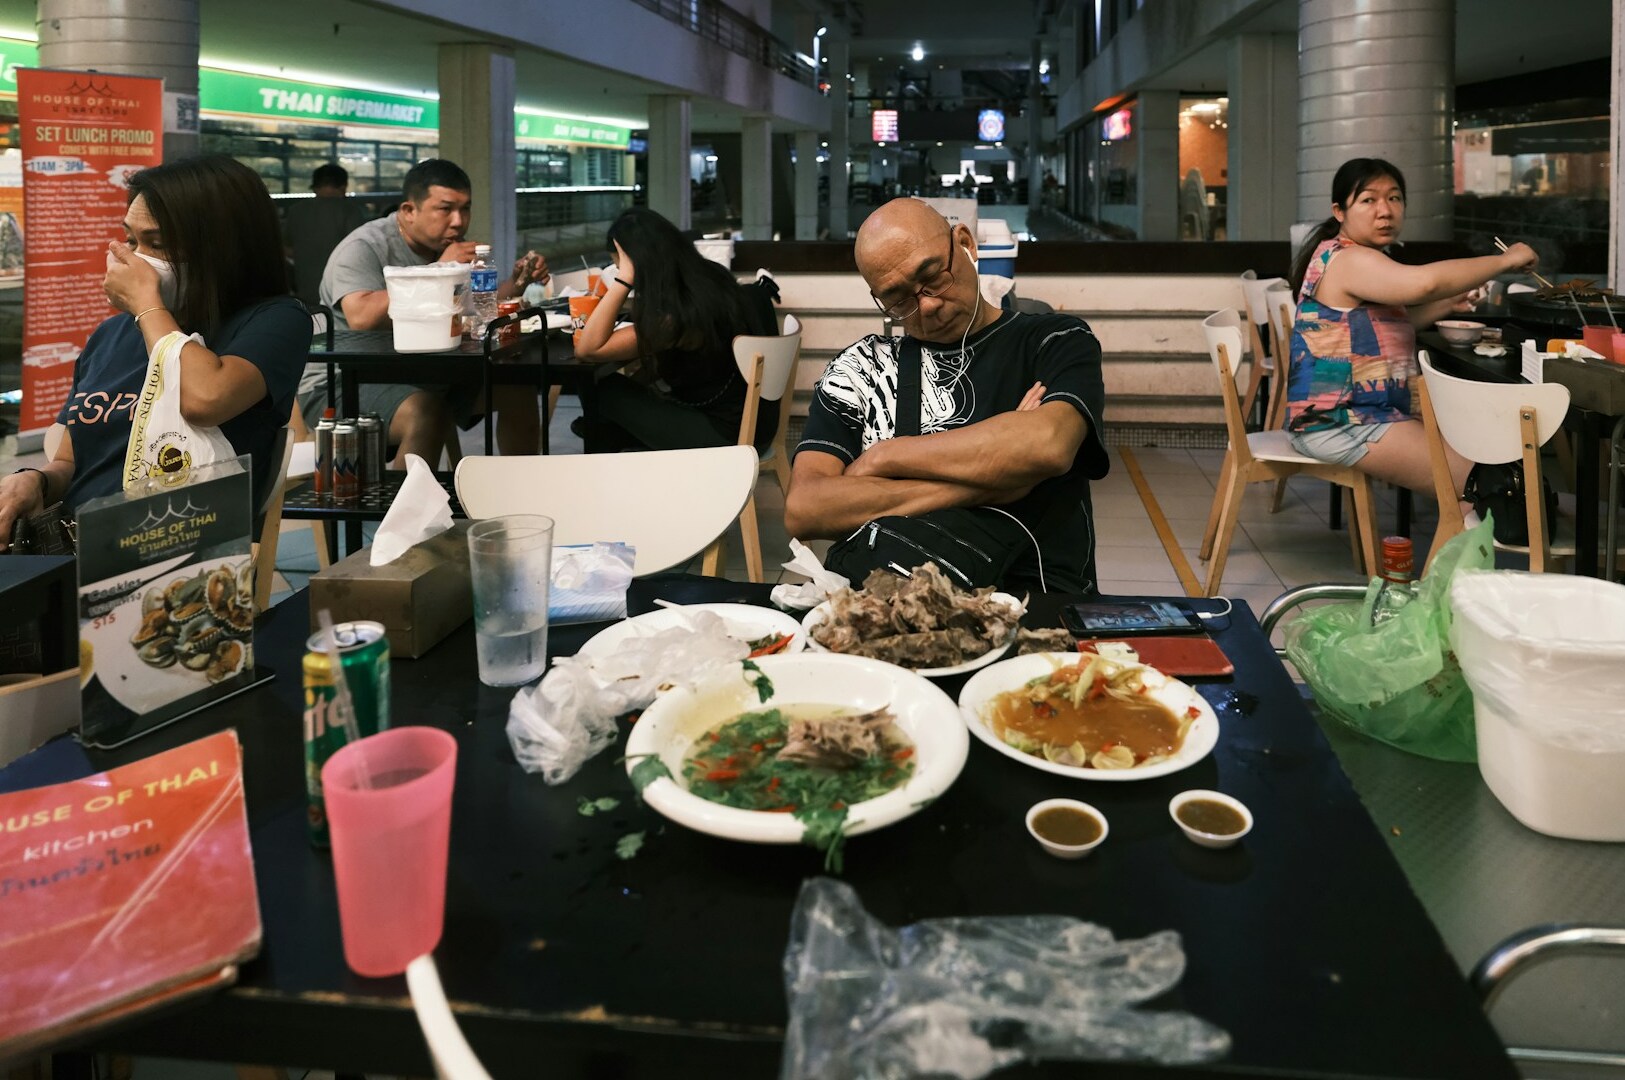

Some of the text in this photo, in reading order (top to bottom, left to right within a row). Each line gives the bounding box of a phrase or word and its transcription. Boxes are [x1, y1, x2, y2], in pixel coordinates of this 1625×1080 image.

[33, 95, 140, 108] HOUSE OF THAI
[259, 87, 424, 123] THAI SUPERMARKET
[36, 126, 154, 144] SET LUNCH PROMO
[59, 144, 154, 156] COMES WITH FREE DRINK
[30, 160, 56, 171] 11AM
[65, 160, 84, 171] 3PM
[140, 363, 161, 420] GOLDEN
[120, 512, 216, 549] HOUSE OF THAI
[93, 613, 116, 630] $15
[0, 761, 219, 833] USE OF THAI
[22, 817, 154, 863] kitchen
